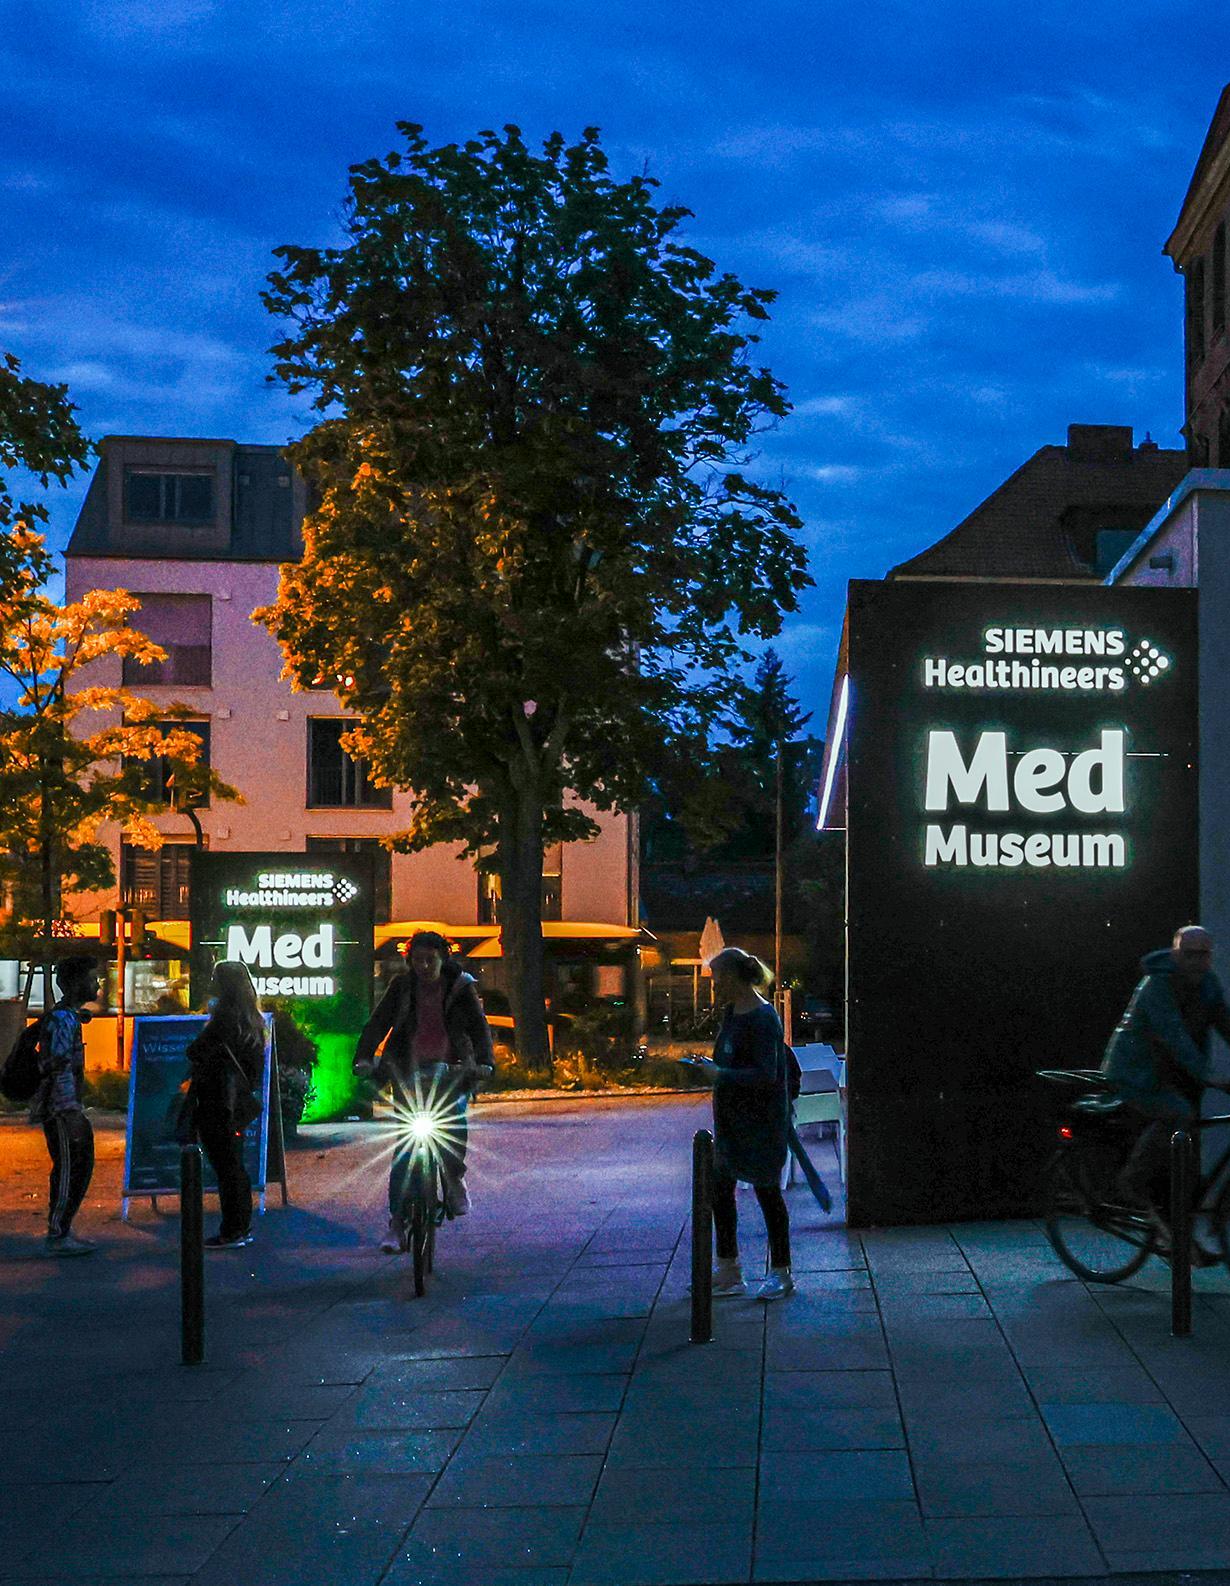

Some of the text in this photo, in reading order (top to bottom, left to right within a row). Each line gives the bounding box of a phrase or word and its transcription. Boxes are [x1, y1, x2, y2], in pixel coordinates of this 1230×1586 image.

[985, 628, 1125, 656] SIEMENS
[925, 658, 1125, 690] Healthineers
[925, 729, 1125, 813] Med
[924, 824, 1126, 868] Museum
[258, 873, 334, 888] SIEMENS
[226, 889, 334, 906] Healthineers
[226, 924, 334, 968] Med
[252, 975, 334, 996] useum
